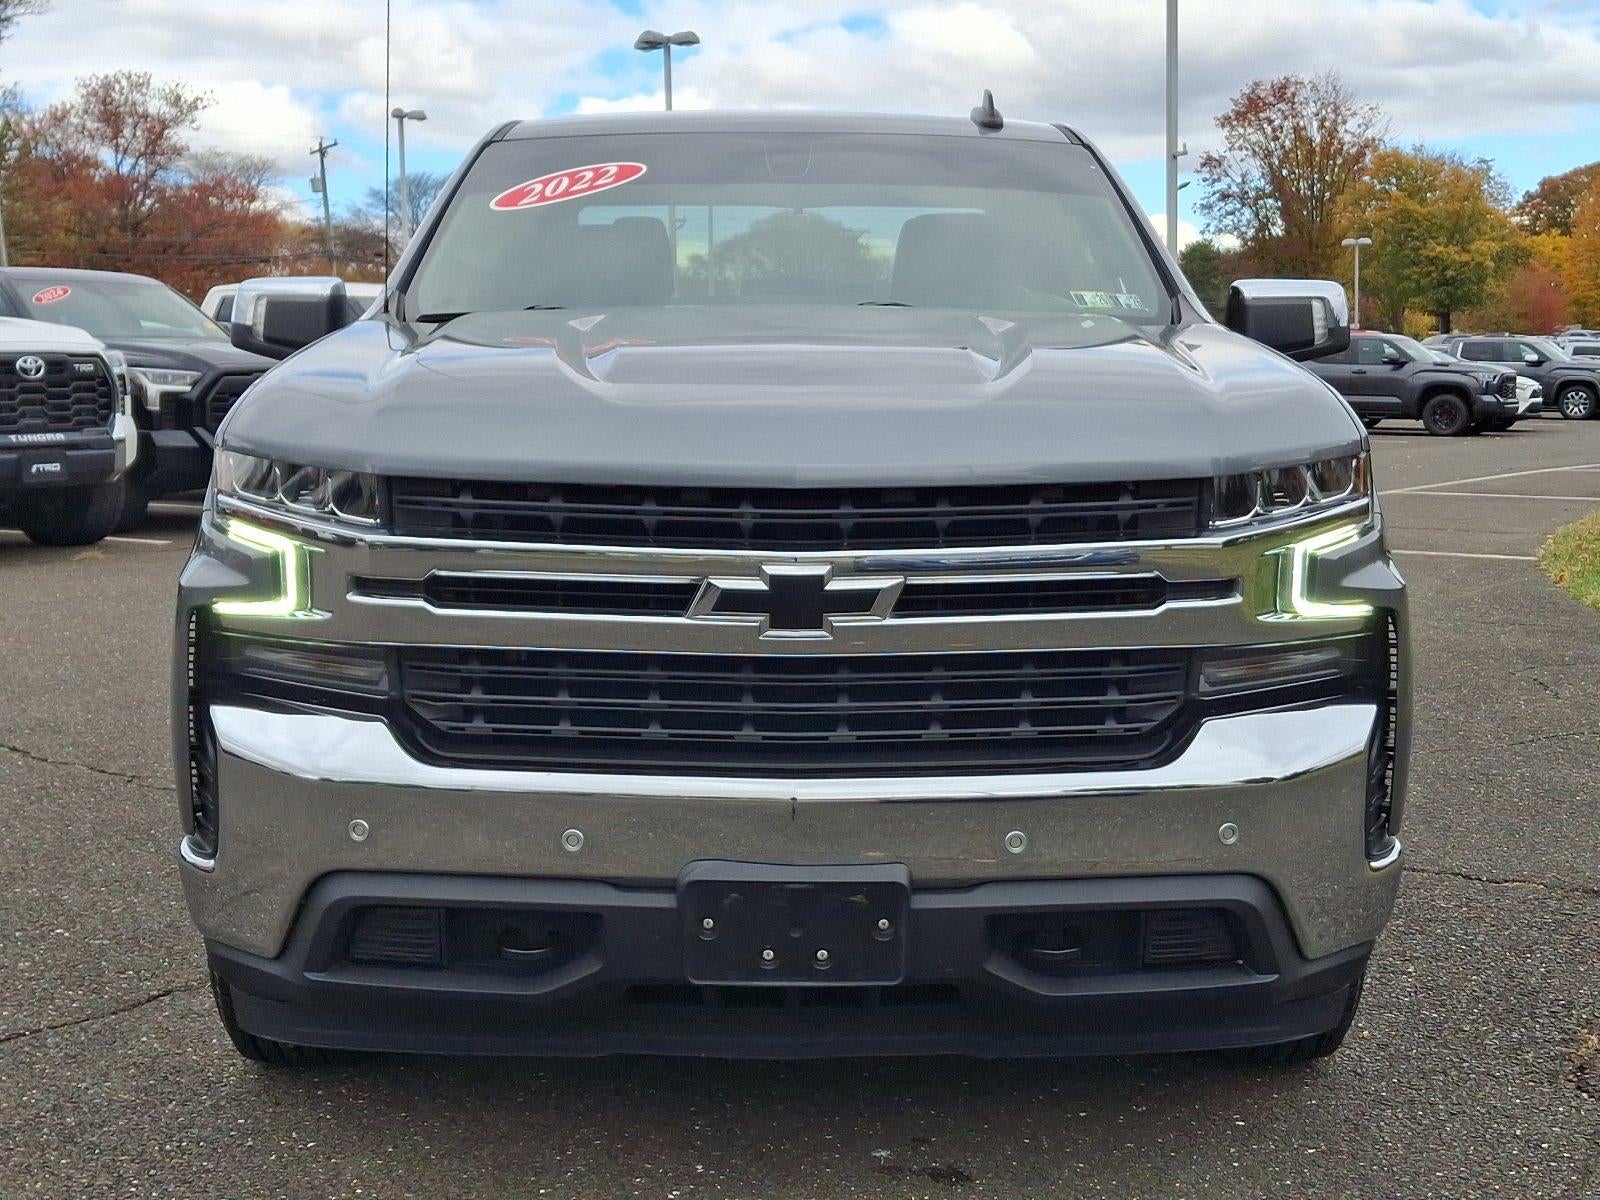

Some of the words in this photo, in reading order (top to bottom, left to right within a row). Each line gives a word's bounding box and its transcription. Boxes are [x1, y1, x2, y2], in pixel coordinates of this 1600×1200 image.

[517, 165, 618, 206] 2022
[73, 363, 94, 371] TRD
[8, 433, 65, 442] TUNDRA
[37, 463, 61, 472] TRD
